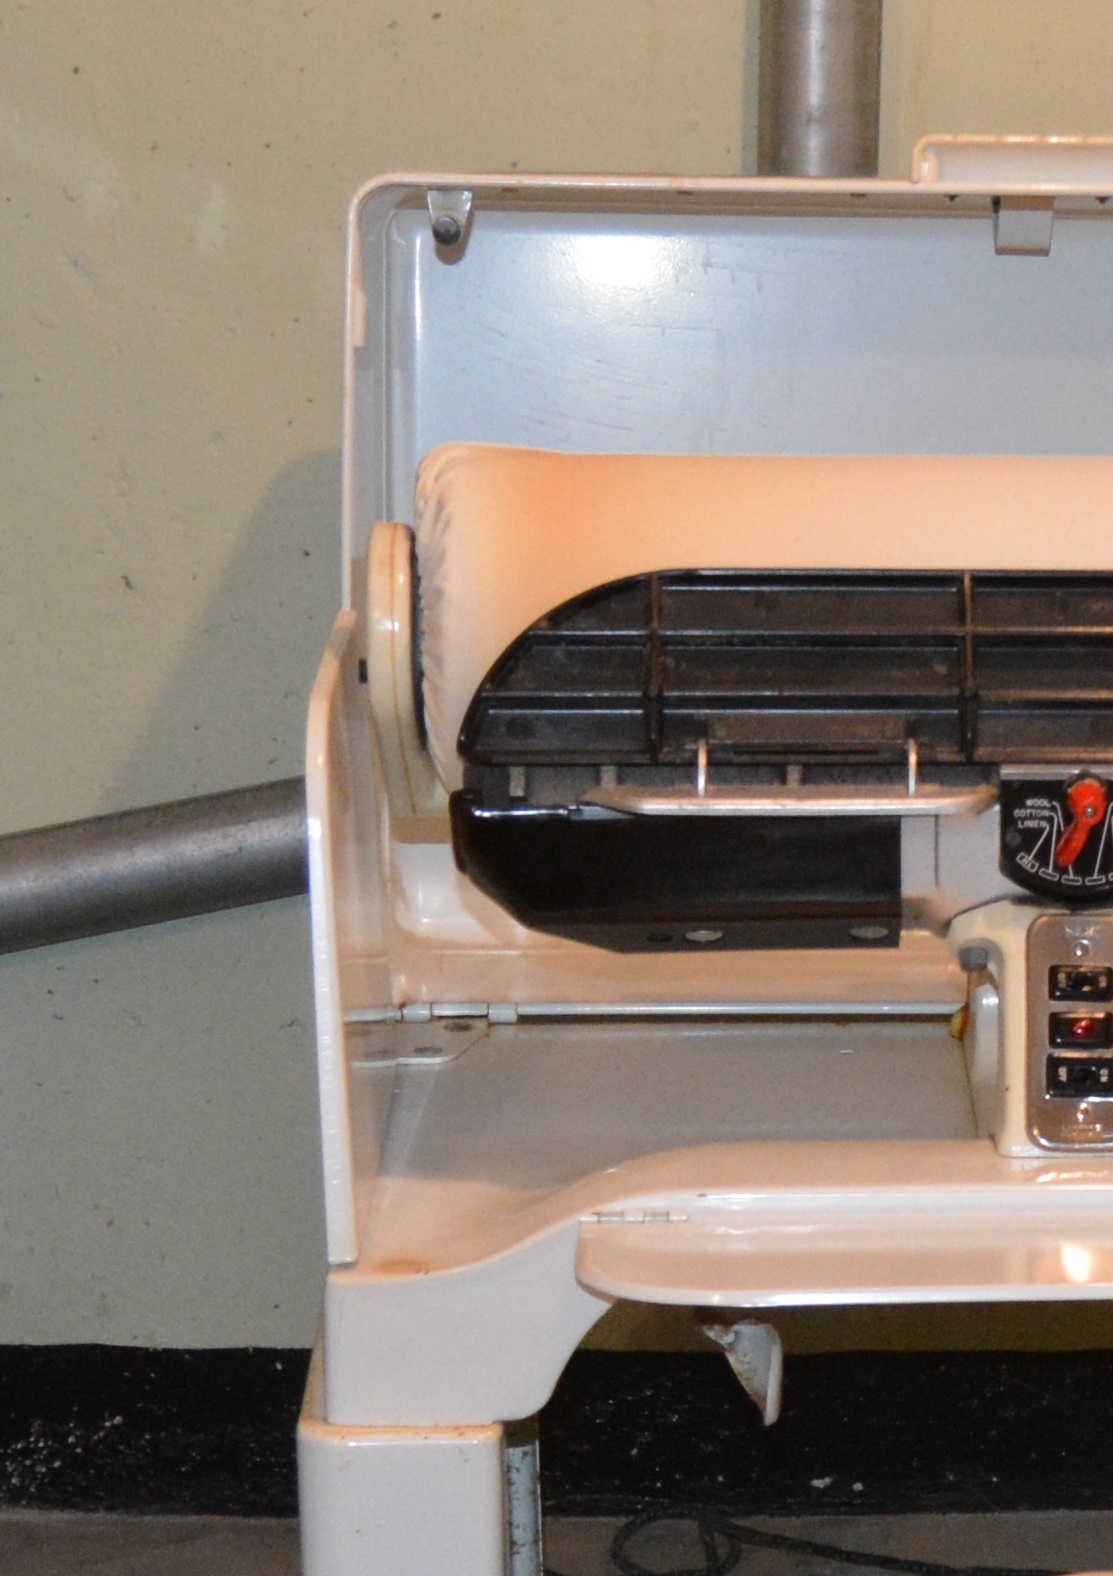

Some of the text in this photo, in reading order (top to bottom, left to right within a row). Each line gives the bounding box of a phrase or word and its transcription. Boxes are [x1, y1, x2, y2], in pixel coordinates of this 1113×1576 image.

[1026, 798, 1051, 807] WOOL
[1013, 808, 1049, 817] COTTON
[1017, 820, 1046, 828] LINEN
[1058, 1066, 1067, 1083] OFF
[1099, 1069, 1108, 1083] ON
